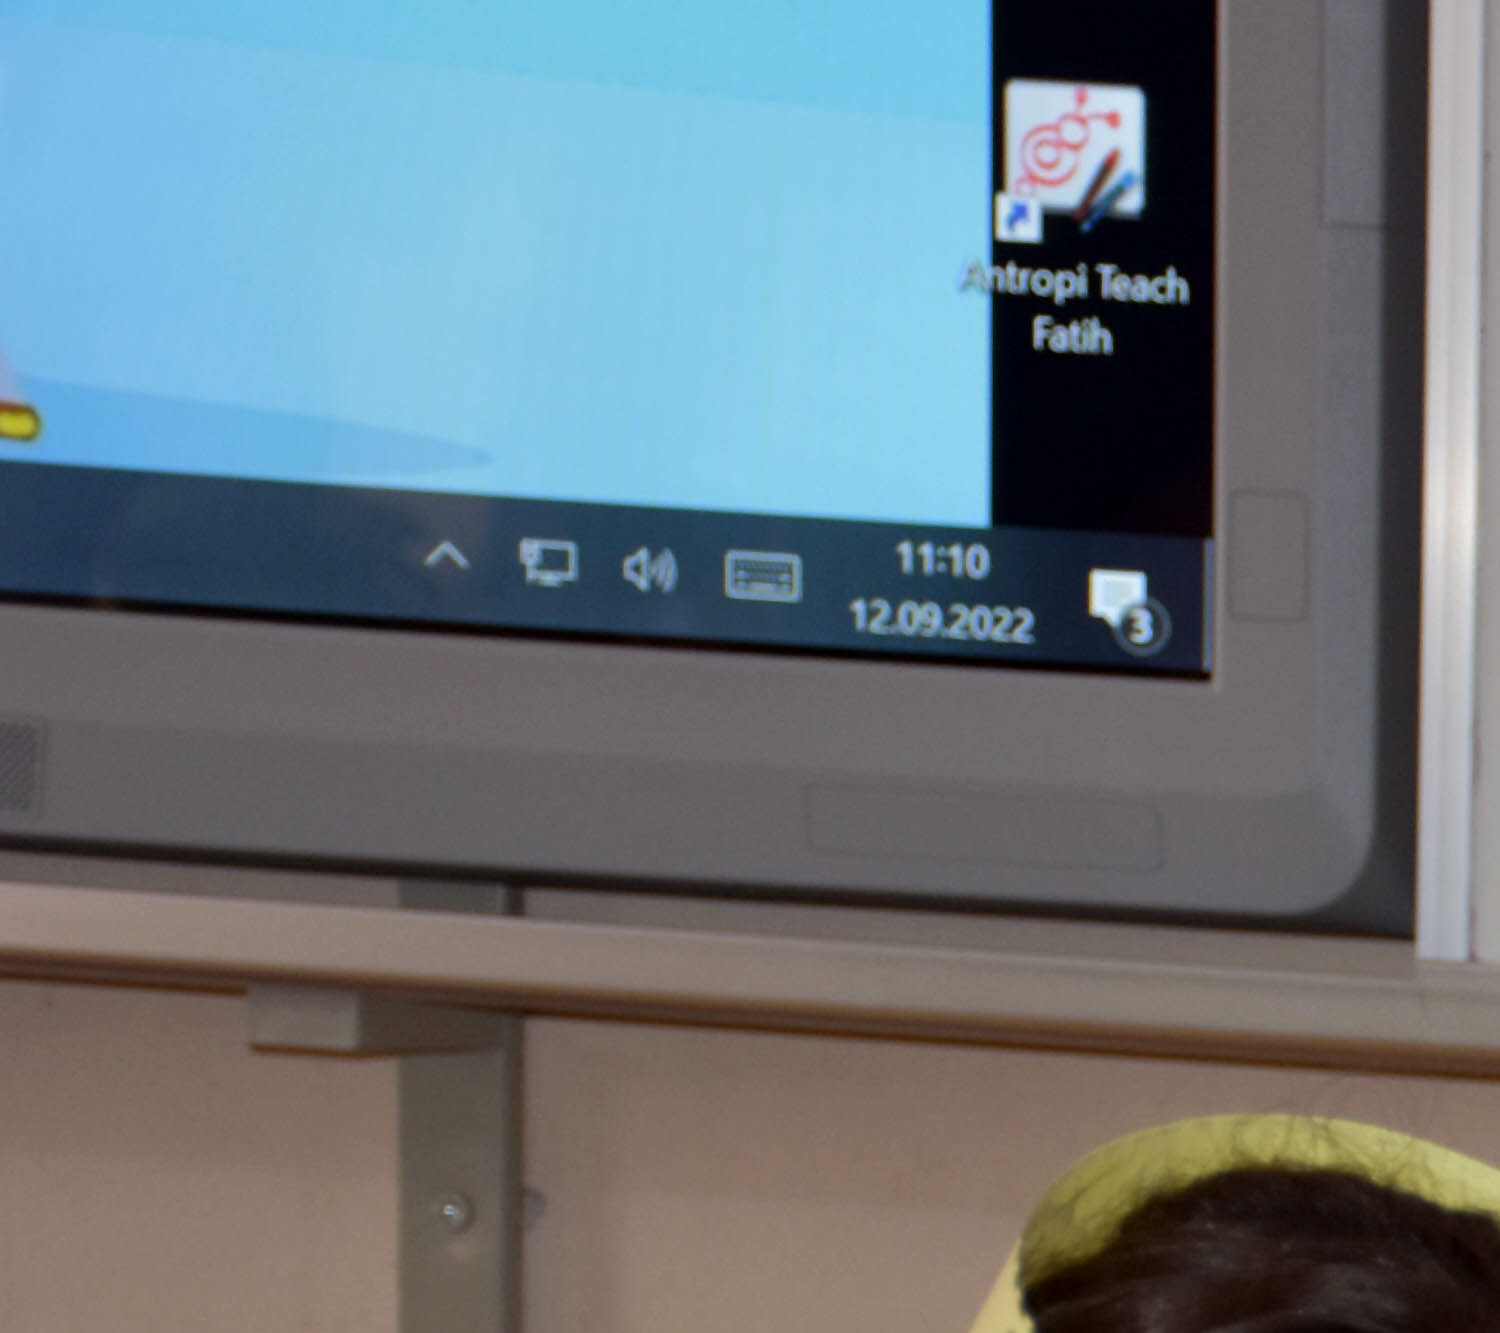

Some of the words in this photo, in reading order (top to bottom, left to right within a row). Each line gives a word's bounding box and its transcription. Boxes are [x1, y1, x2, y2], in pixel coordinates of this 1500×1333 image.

[959, 259, 1088, 306] Antropi
[1095, 262, 1190, 305] Teach
[1032, 314, 1114, 355] Fatih
[896, 540, 991, 580] 11:10
[849, 597, 1036, 645] 12.09.2022
[1130, 607, 1153, 645] 3
